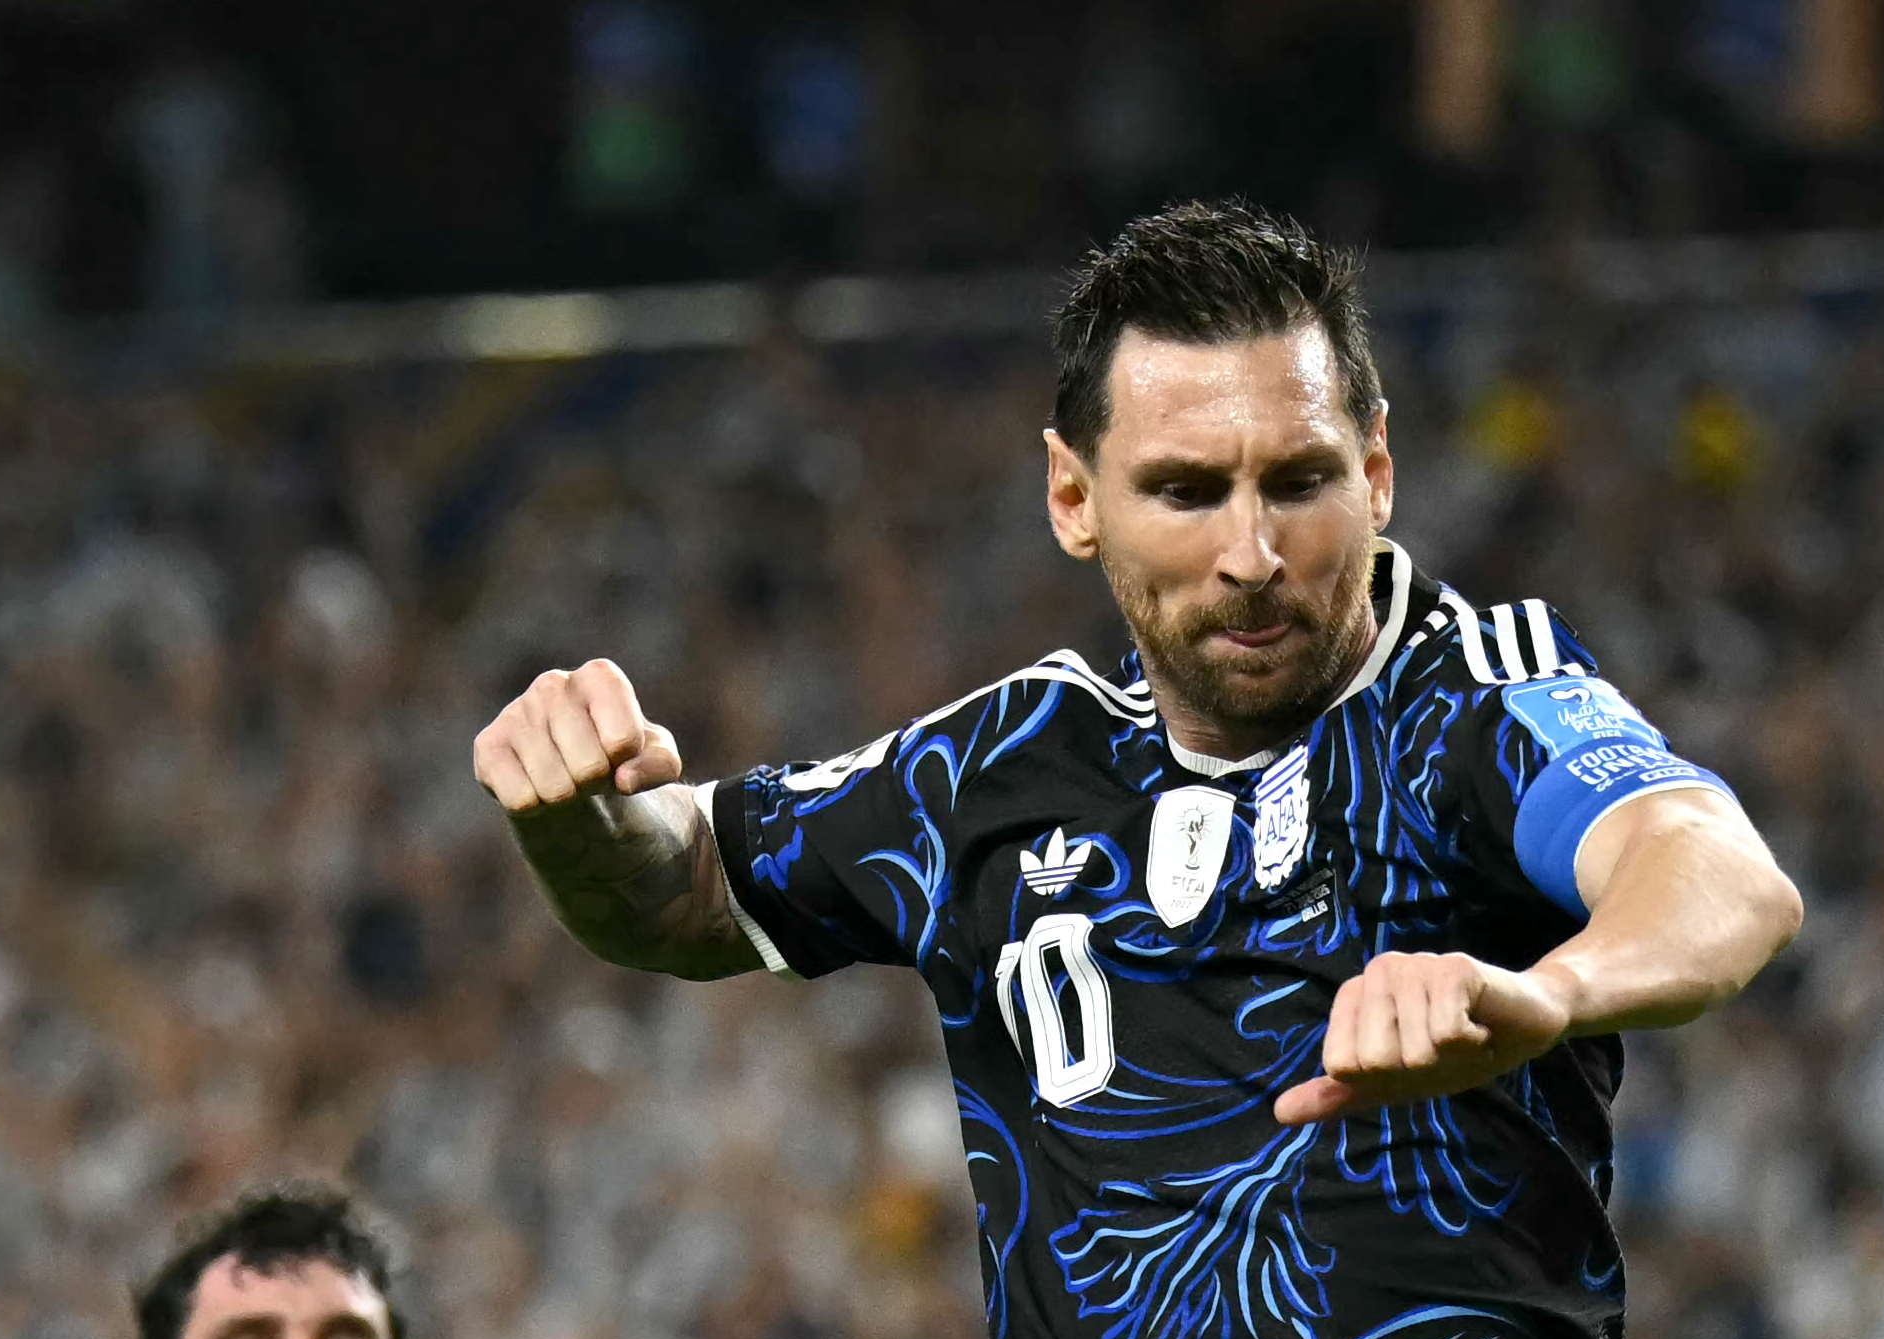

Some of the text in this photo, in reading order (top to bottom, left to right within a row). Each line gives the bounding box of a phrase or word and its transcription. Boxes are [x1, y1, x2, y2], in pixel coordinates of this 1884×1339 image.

[1570, 714, 1631, 733] PEACE
[1171, 875, 1206, 894] FIFA
[995, 914, 1115, 1108] 10
